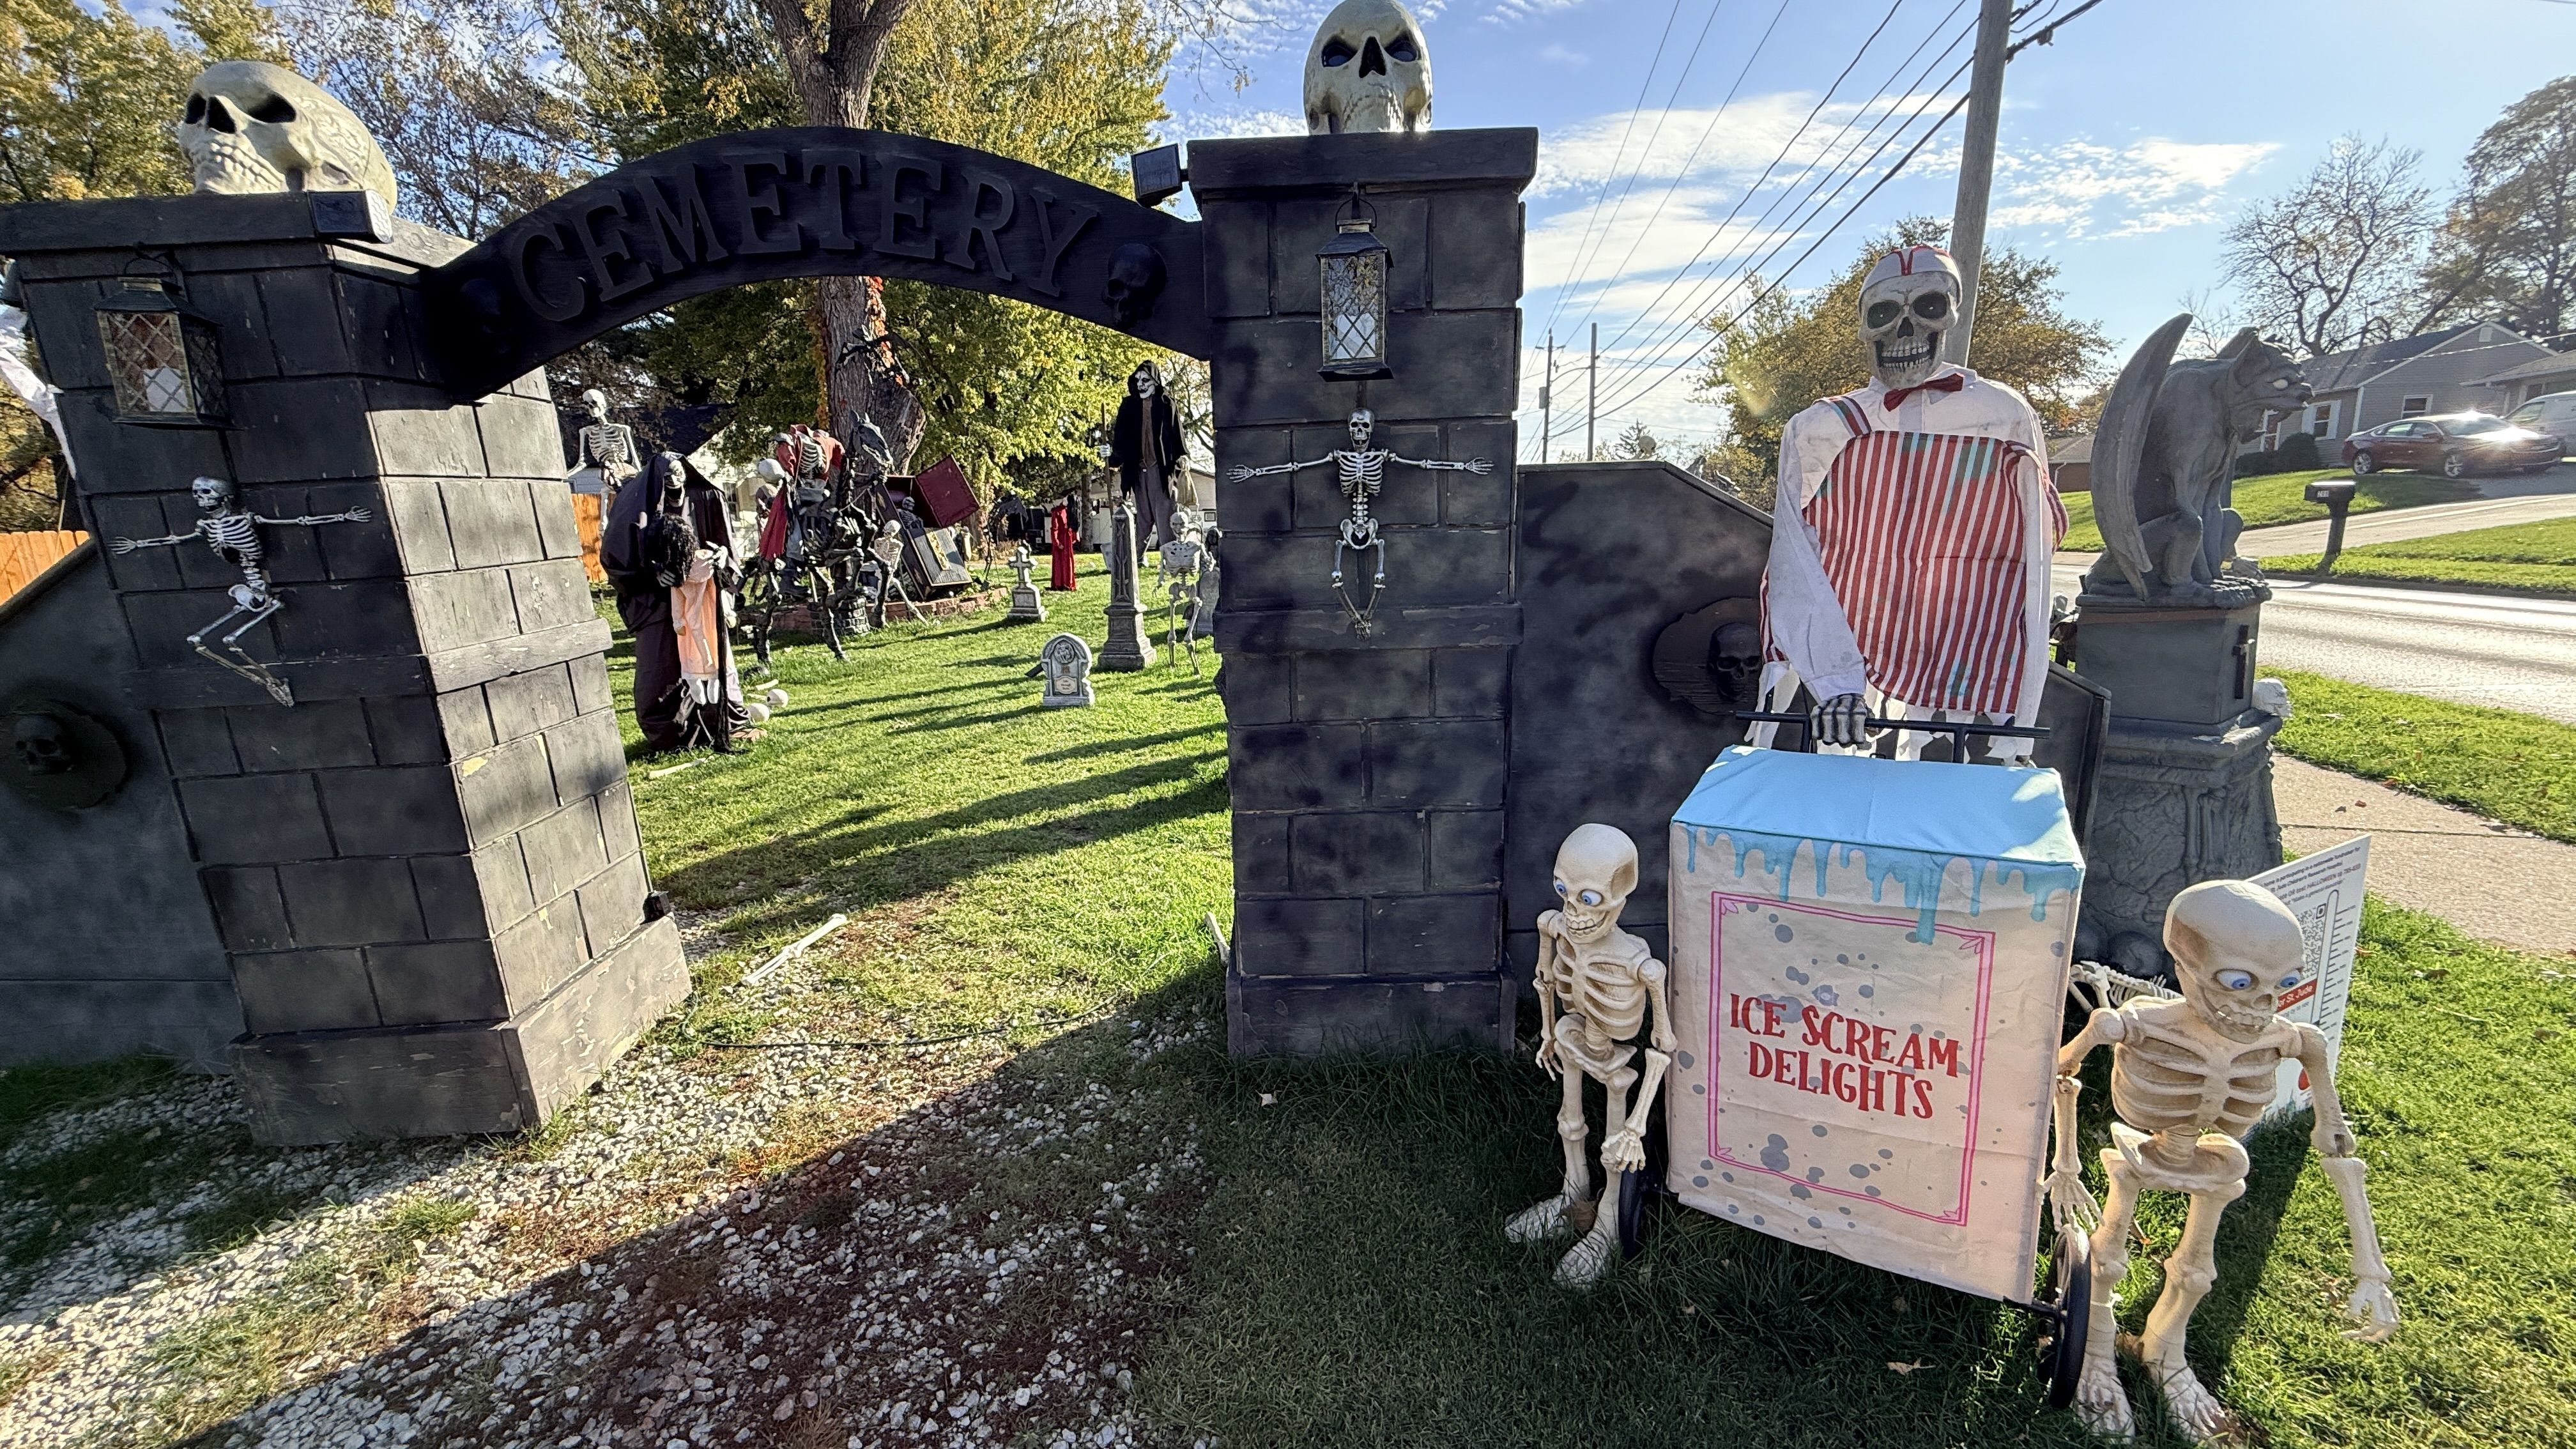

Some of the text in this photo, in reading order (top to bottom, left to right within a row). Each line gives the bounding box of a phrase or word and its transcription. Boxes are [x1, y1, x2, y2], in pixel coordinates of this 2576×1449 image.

[515, 151, 1098, 319] CEMETERY
[2280, 869, 2304, 882] participating
[2313, 857, 2334, 867] nationwide
[2334, 848, 2354, 859] fundraiser
[2307, 874, 2336, 889] HALLOWEEN
[2308, 868, 2326, 877] Research
[2296, 985, 2313, 999] Jude
[1730, 993, 1959, 1077] ICE SCREAM
[1749, 1041, 1933, 1119] DELIGHTS
